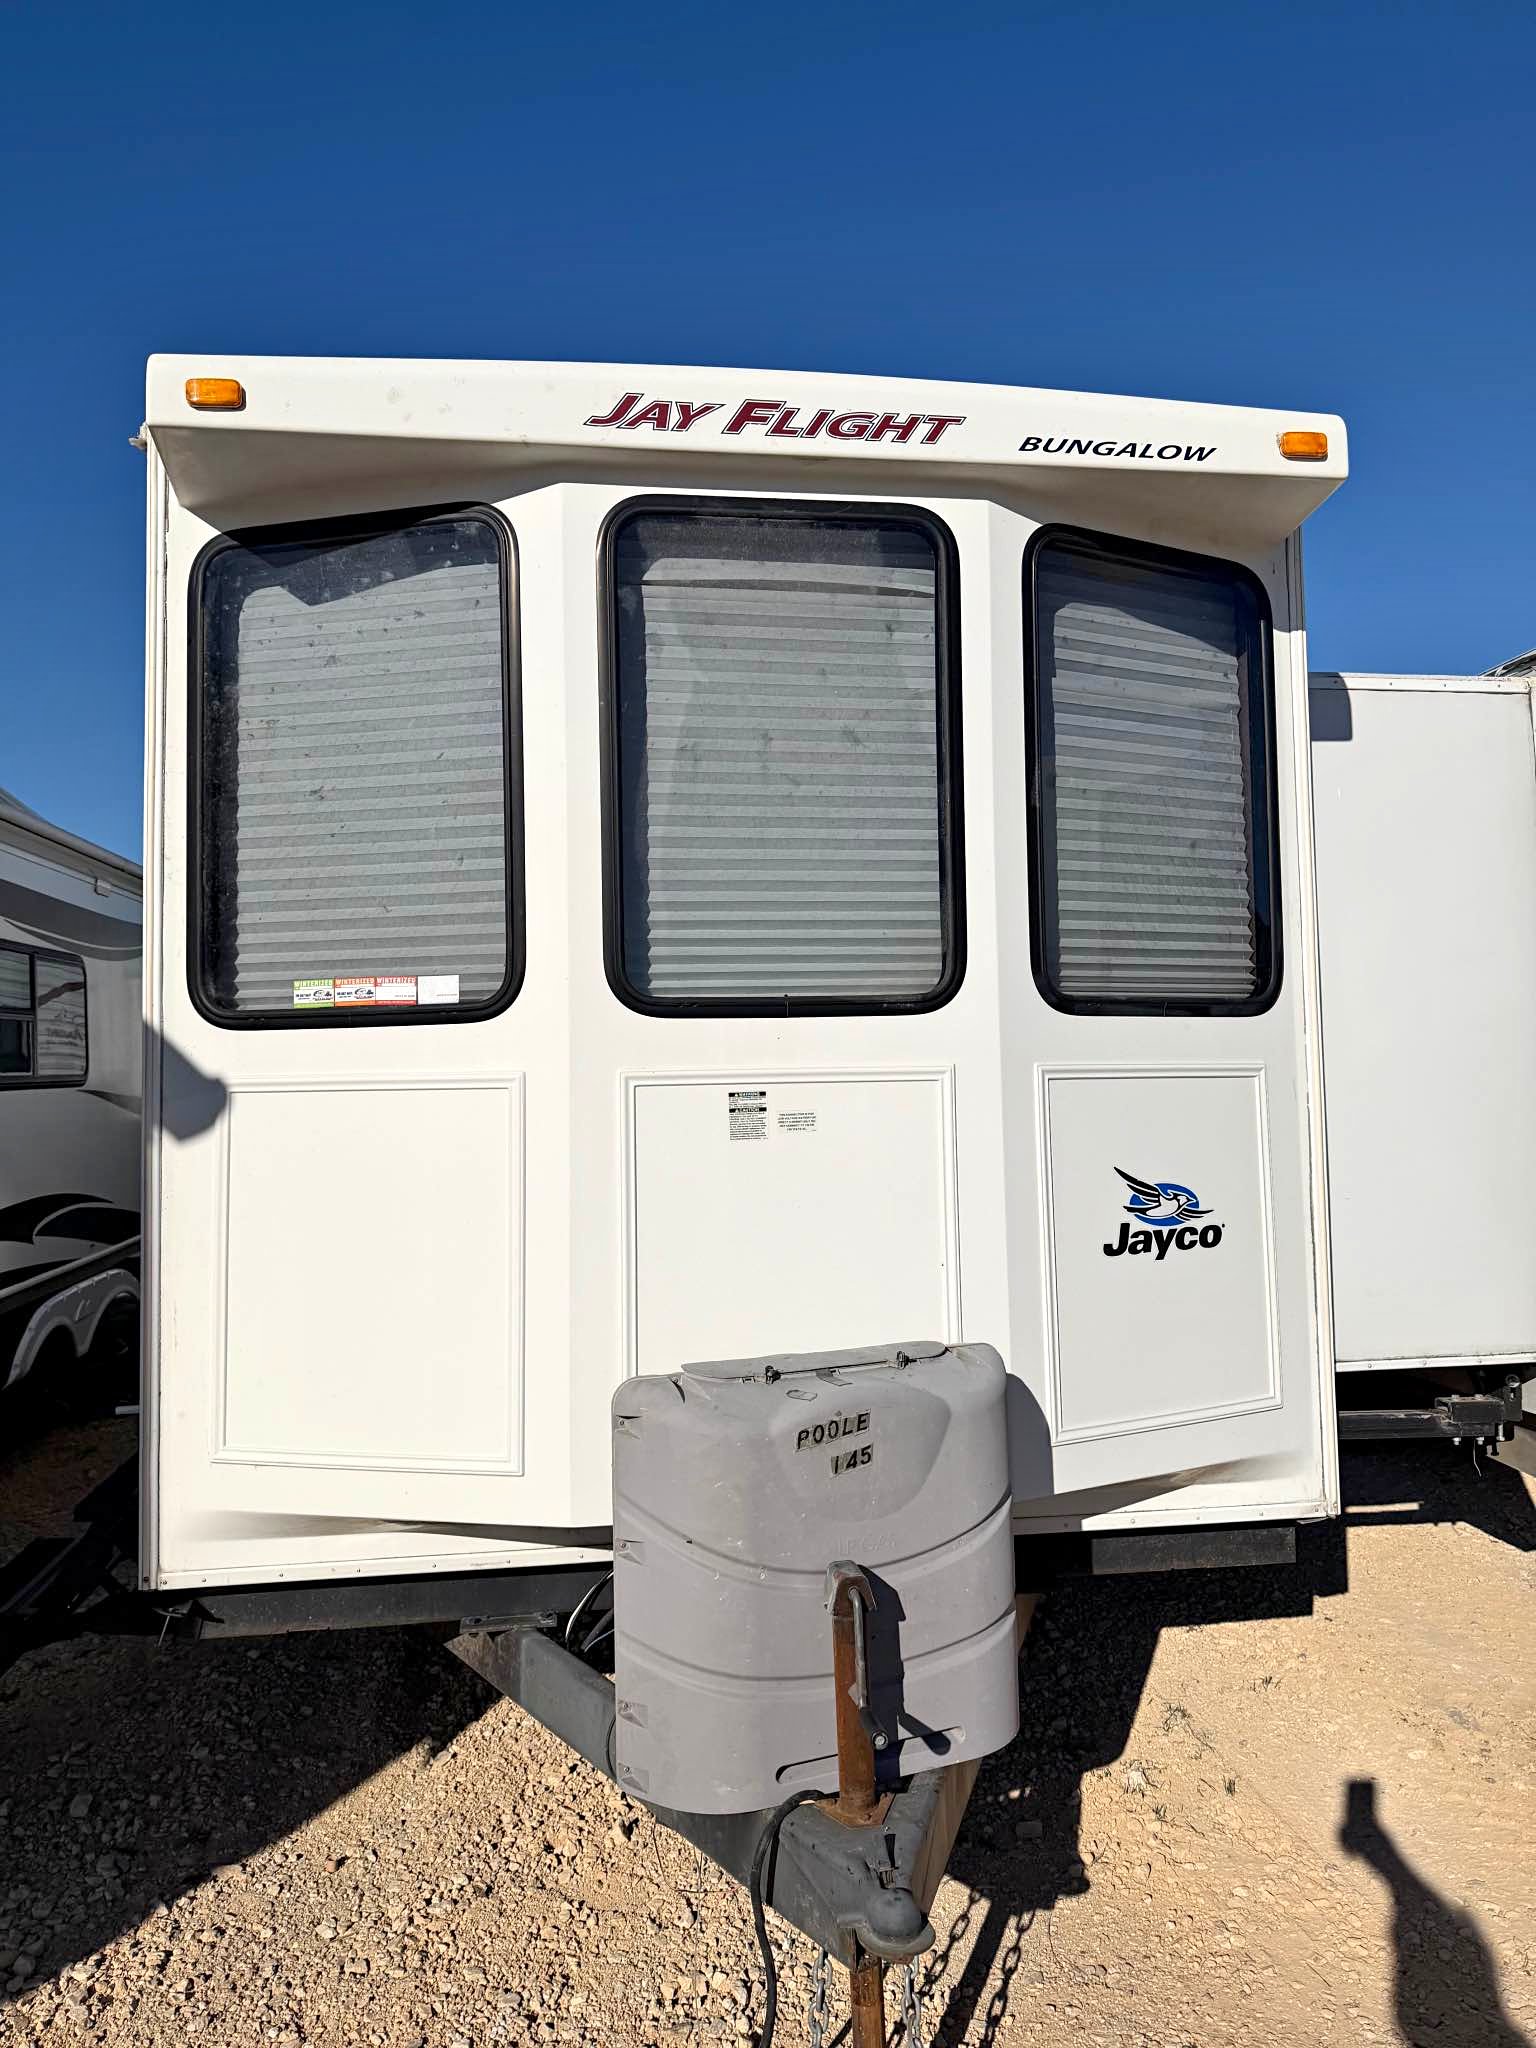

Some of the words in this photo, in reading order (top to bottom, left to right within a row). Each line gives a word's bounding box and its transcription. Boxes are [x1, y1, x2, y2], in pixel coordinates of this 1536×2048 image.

[583, 392, 726, 432] JAY
[721, 398, 967, 444] FLIGHT
[1018, 436, 1218, 462] BUNGALOW
[1103, 1223, 1223, 1260] Jayco
[797, 1412, 870, 1450] POOLE
